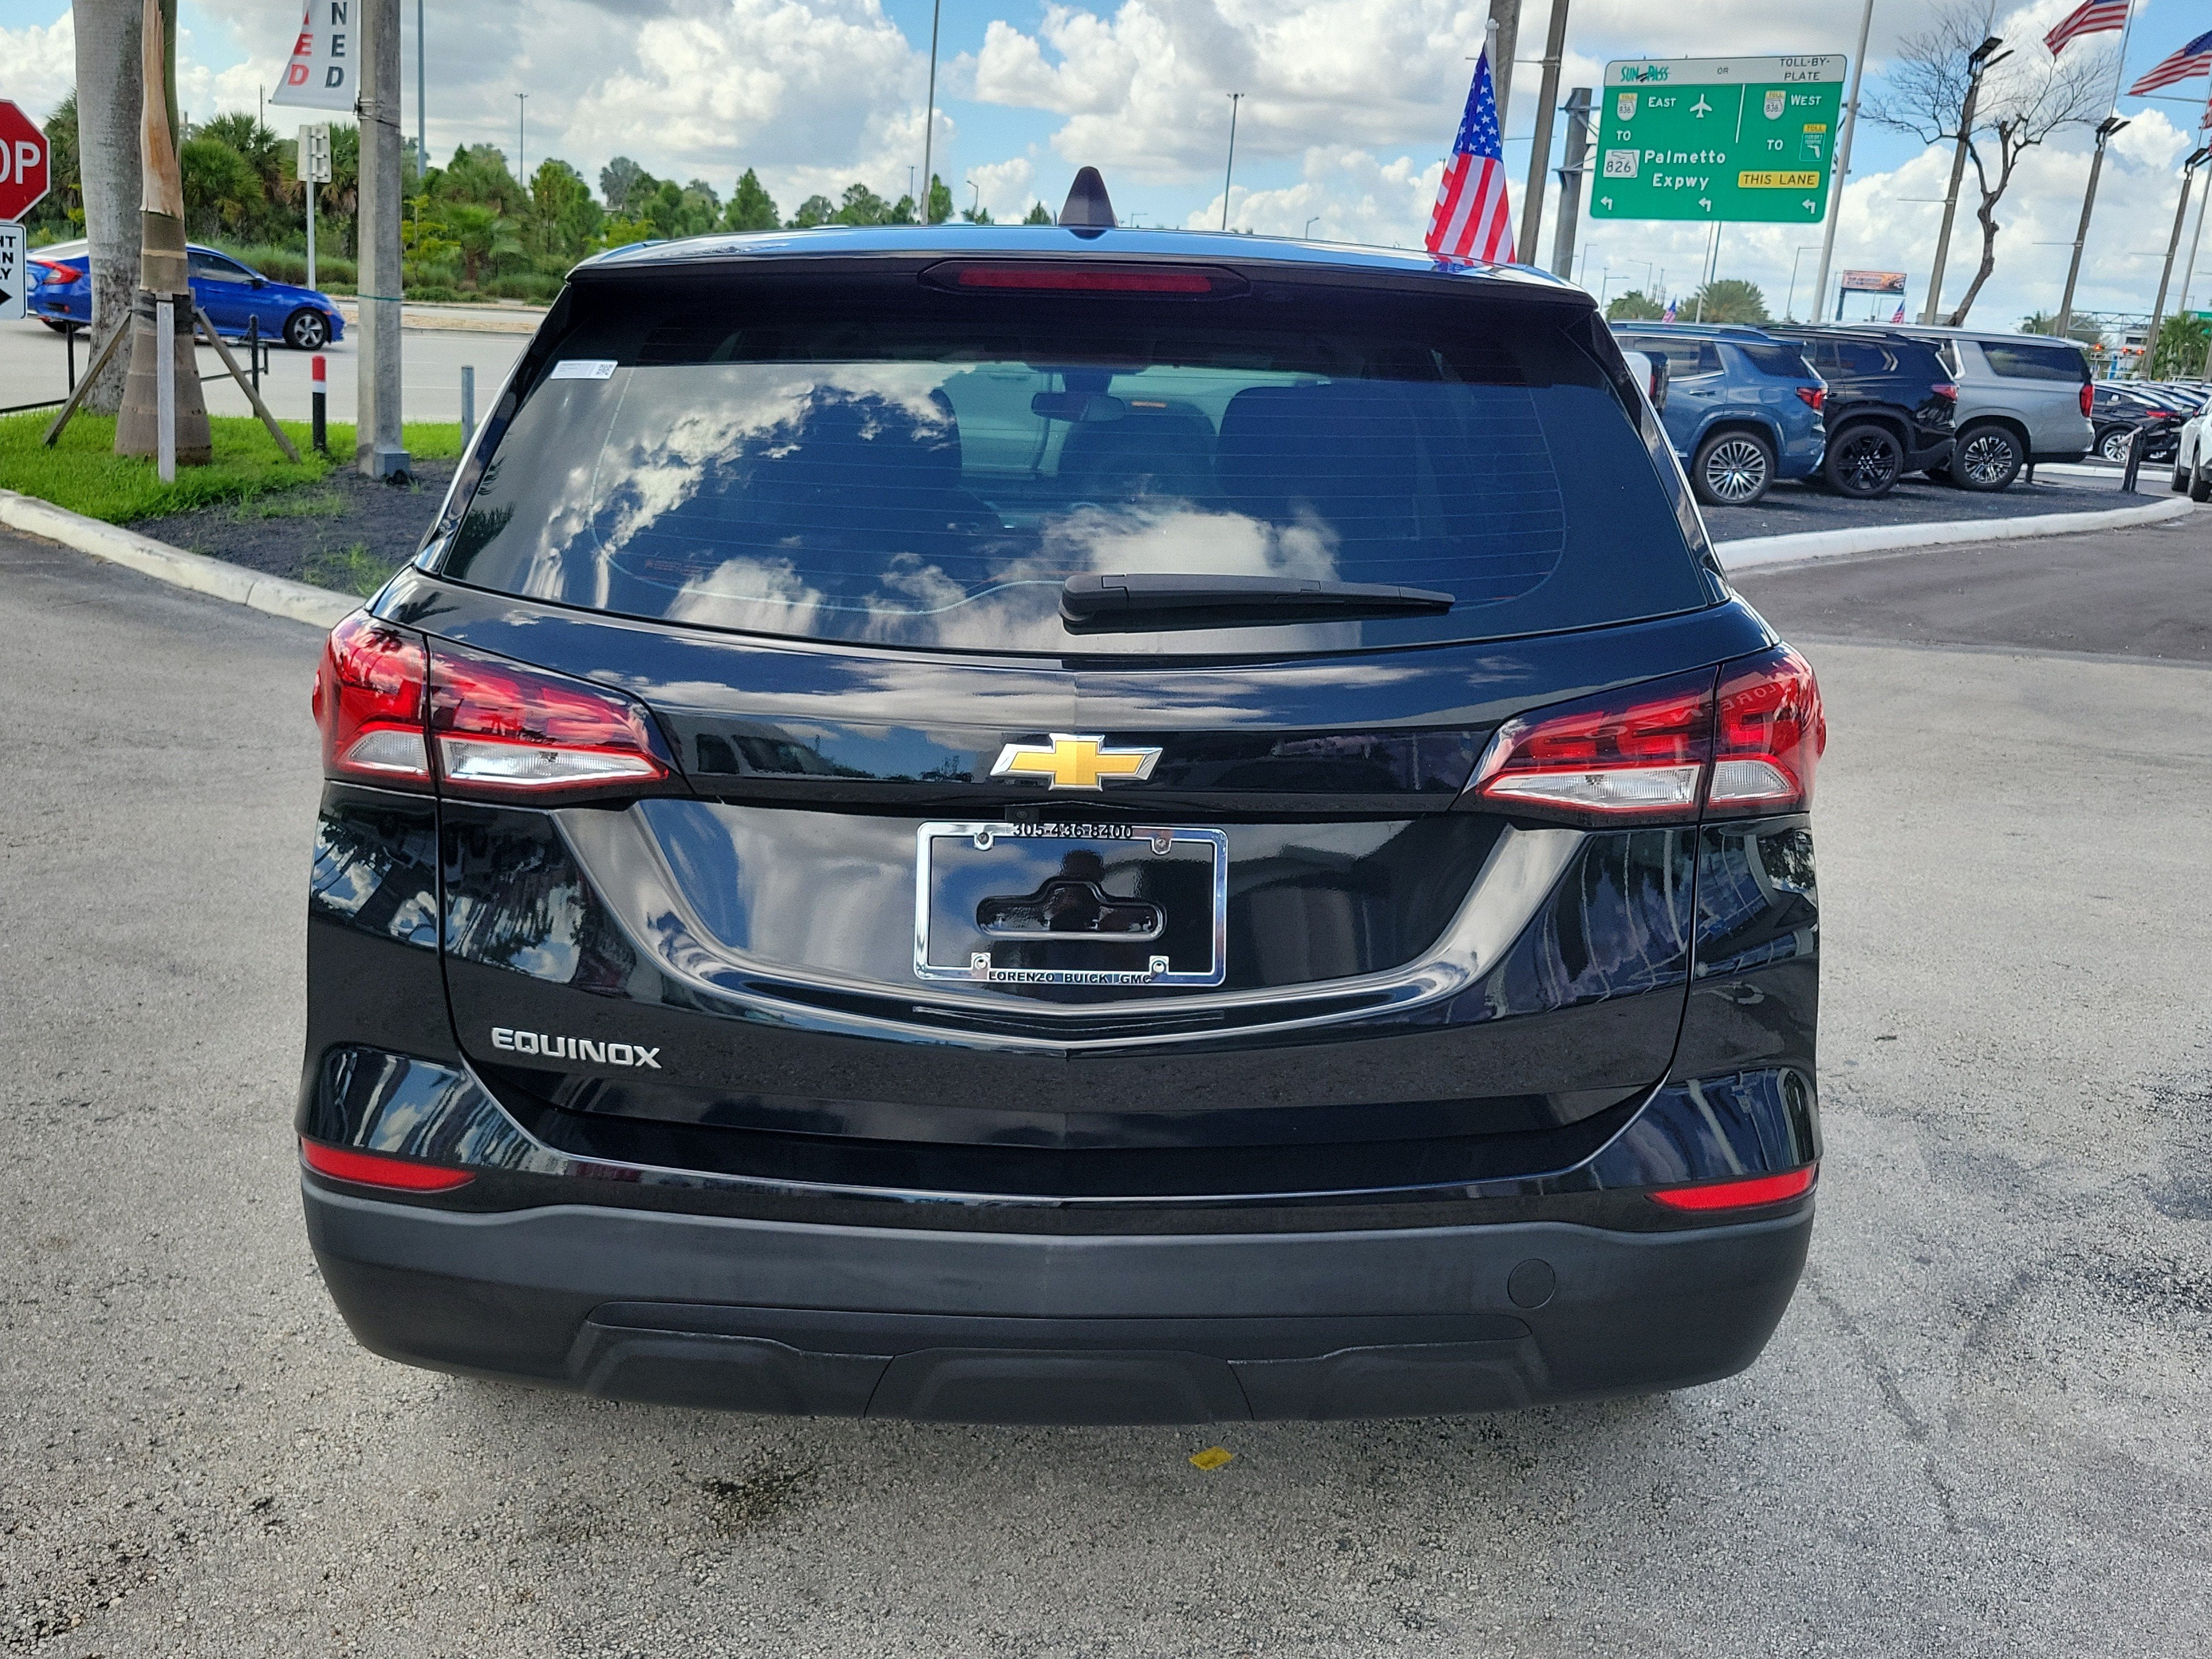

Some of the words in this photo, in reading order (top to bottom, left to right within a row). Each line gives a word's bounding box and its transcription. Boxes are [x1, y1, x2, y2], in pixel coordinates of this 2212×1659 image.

[287, 9, 313, 86] ED
[1785, 72, 1821, 81] PLATE
[1648, 96, 1677, 108] EAST
[1791, 94, 1821, 105] WEST
[1616, 129, 1631, 141] TO
[1767, 139, 1783, 150] TO
[1644, 149, 1726, 164] Palmetto
[1606, 161, 1631, 173] 826
[1652, 172, 1709, 191] Expwy
[1743, 174, 1771, 185] THIS
[1780, 174, 1815, 185] LANE
[1013, 823, 1133, 838] 305-436-8400
[988, 970, 1055, 982] LORENZO
[1064, 973, 1108, 983] BUICK
[1120, 974, 1152, 984] GMC
[492, 1027, 662, 1069] EQUINOX
